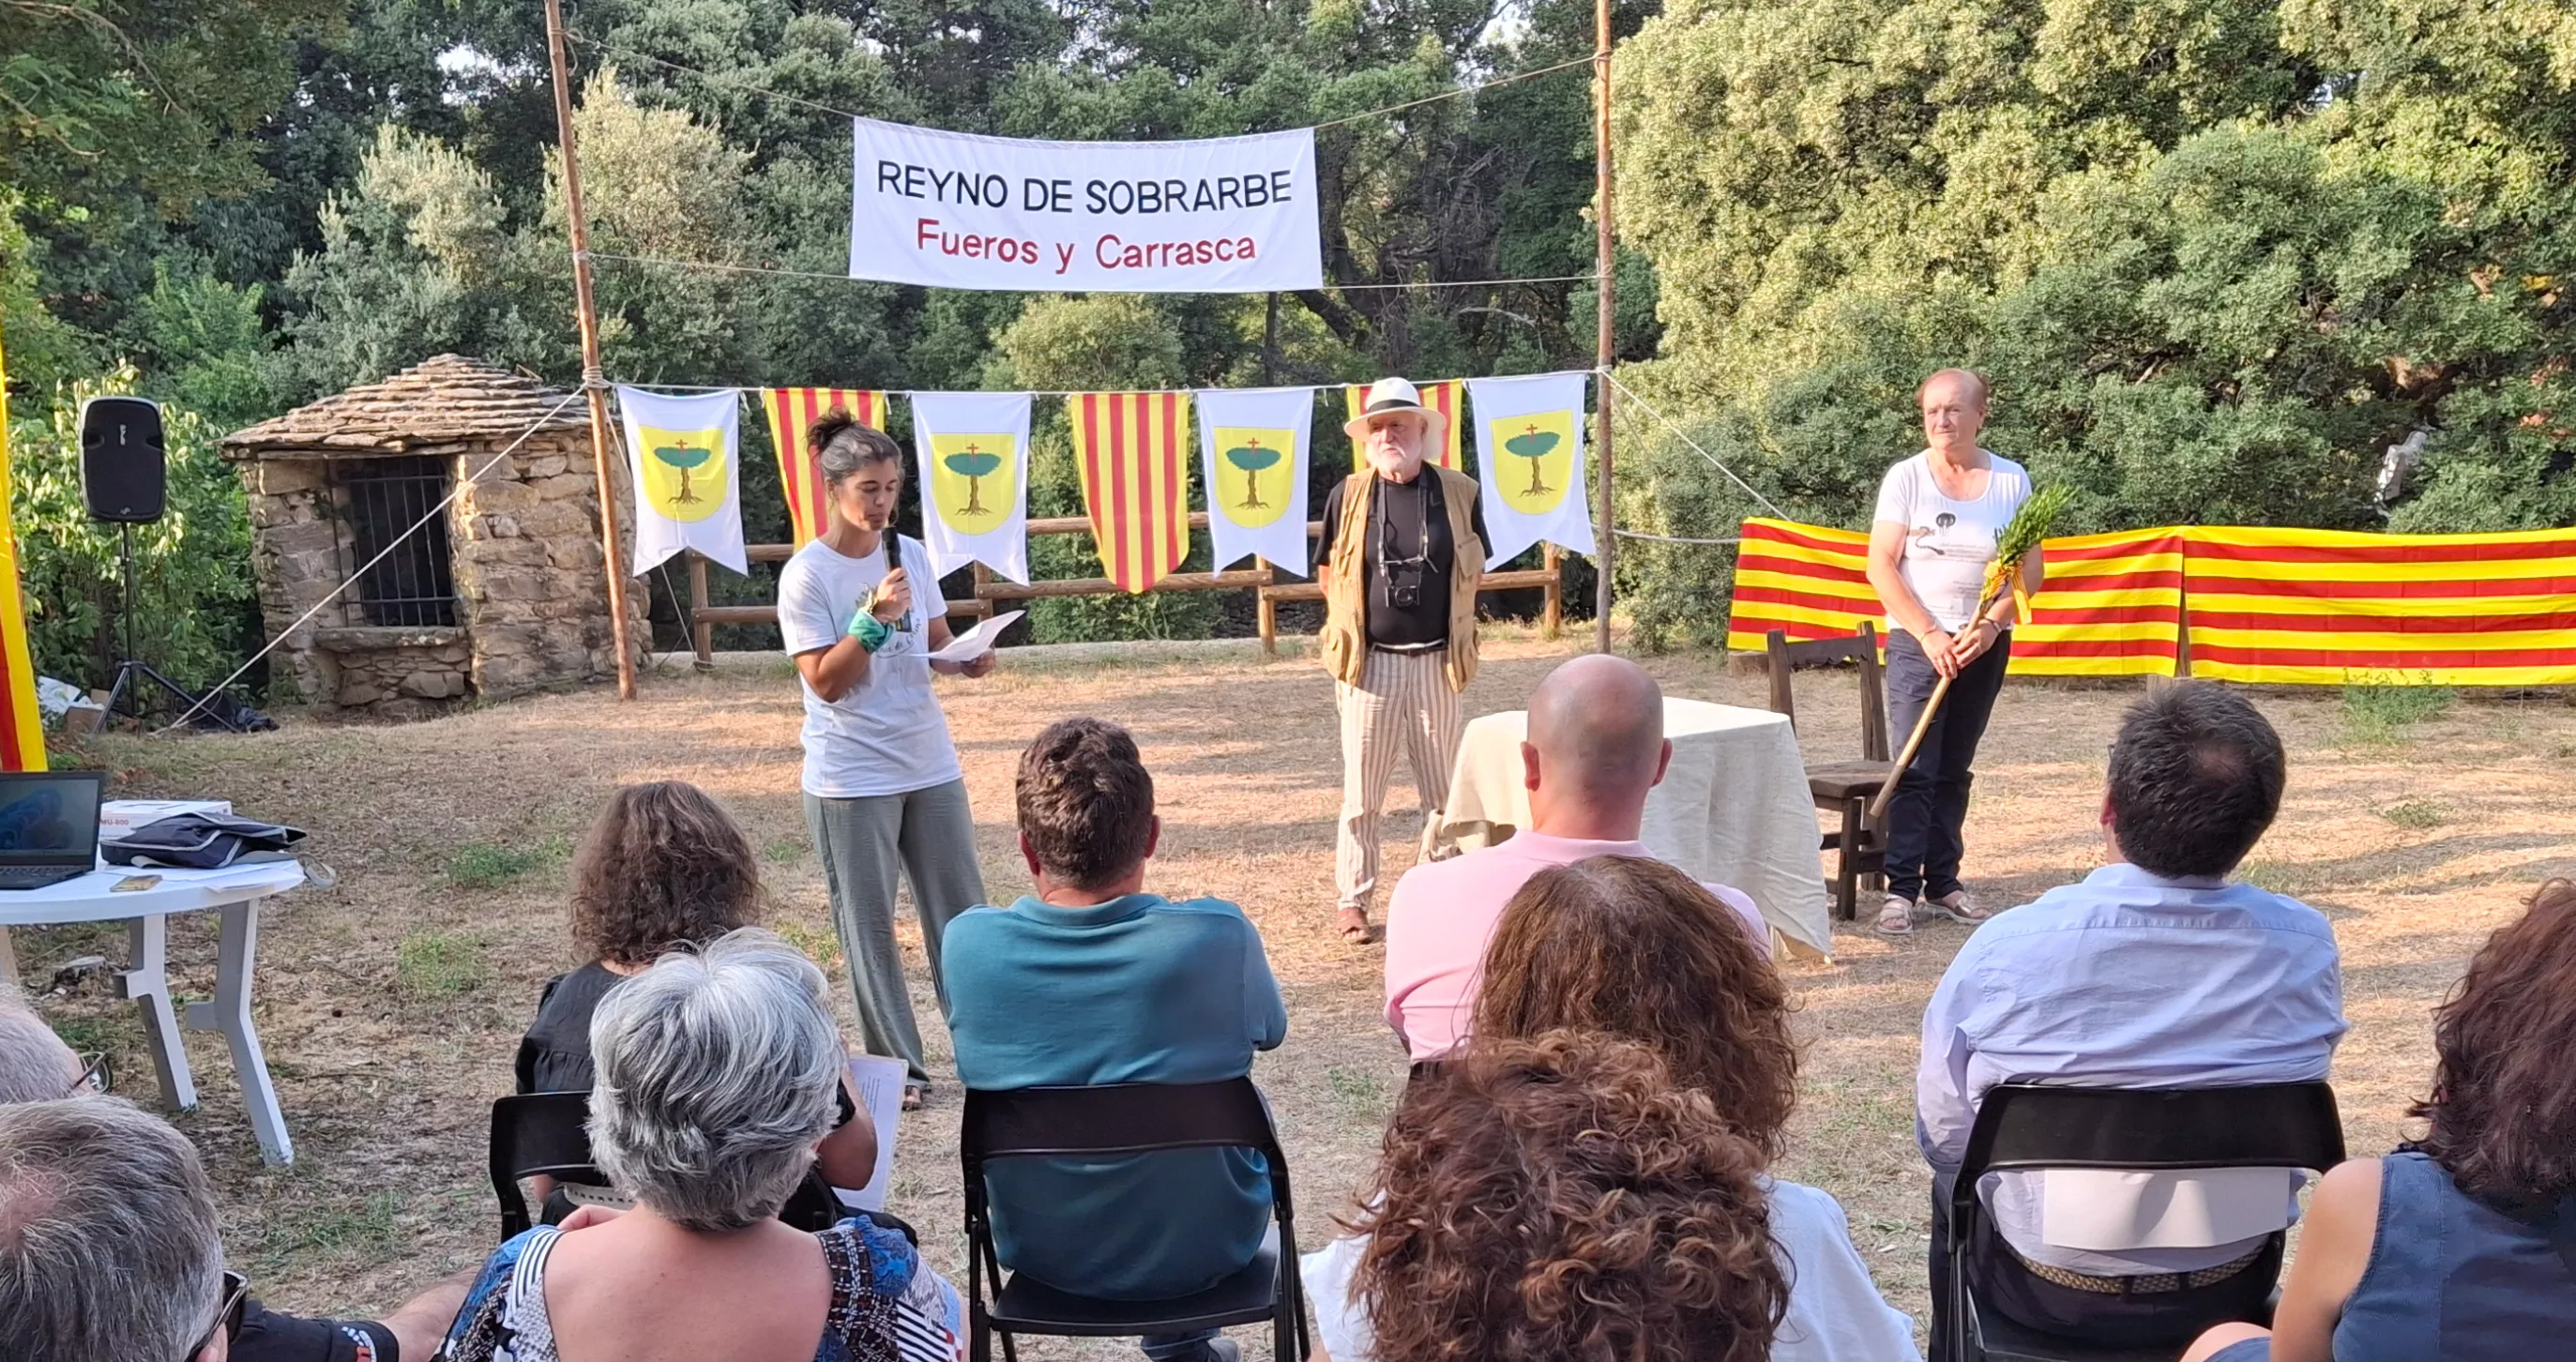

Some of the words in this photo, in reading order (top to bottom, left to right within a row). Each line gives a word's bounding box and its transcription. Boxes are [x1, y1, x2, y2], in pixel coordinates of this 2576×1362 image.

[878, 159, 1008, 208] REYNO
[1023, 177, 1073, 213] DE
[1085, 170, 1293, 215] SOBRARBE
[917, 218, 1039, 264] Fueros
[1056, 243, 1074, 275] y
[1096, 234, 1257, 269] Carrasca
